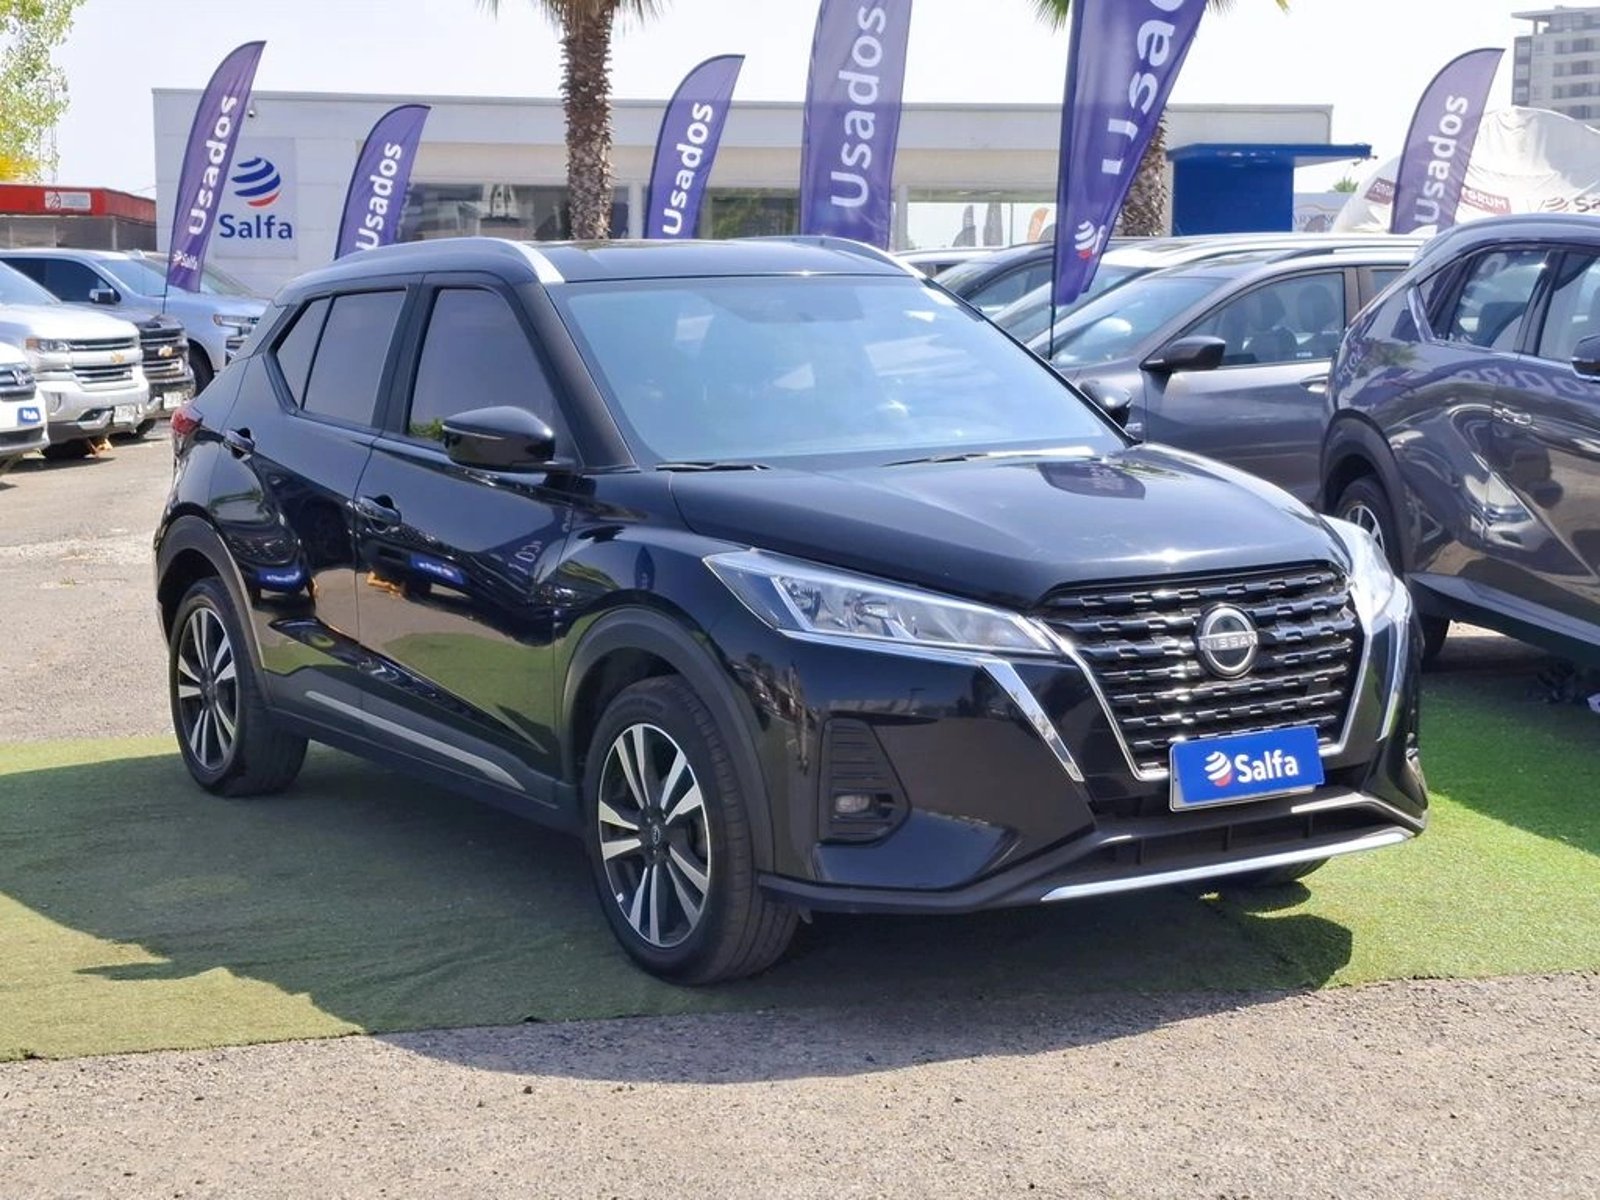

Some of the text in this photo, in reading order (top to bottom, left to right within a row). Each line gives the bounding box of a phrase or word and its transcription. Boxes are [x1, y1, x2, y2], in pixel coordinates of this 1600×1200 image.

[188, 95, 237, 236] Usados
[830, 6, 886, 208] Usados
[1414, 95, 1468, 224] Usados
[218, 213, 293, 240] Salfa
[355, 142, 402, 250] Usados
[662, 102, 713, 235] Usados
[1200, 634, 1257, 650] NISSAN
[1234, 749, 1300, 783] Salfa
